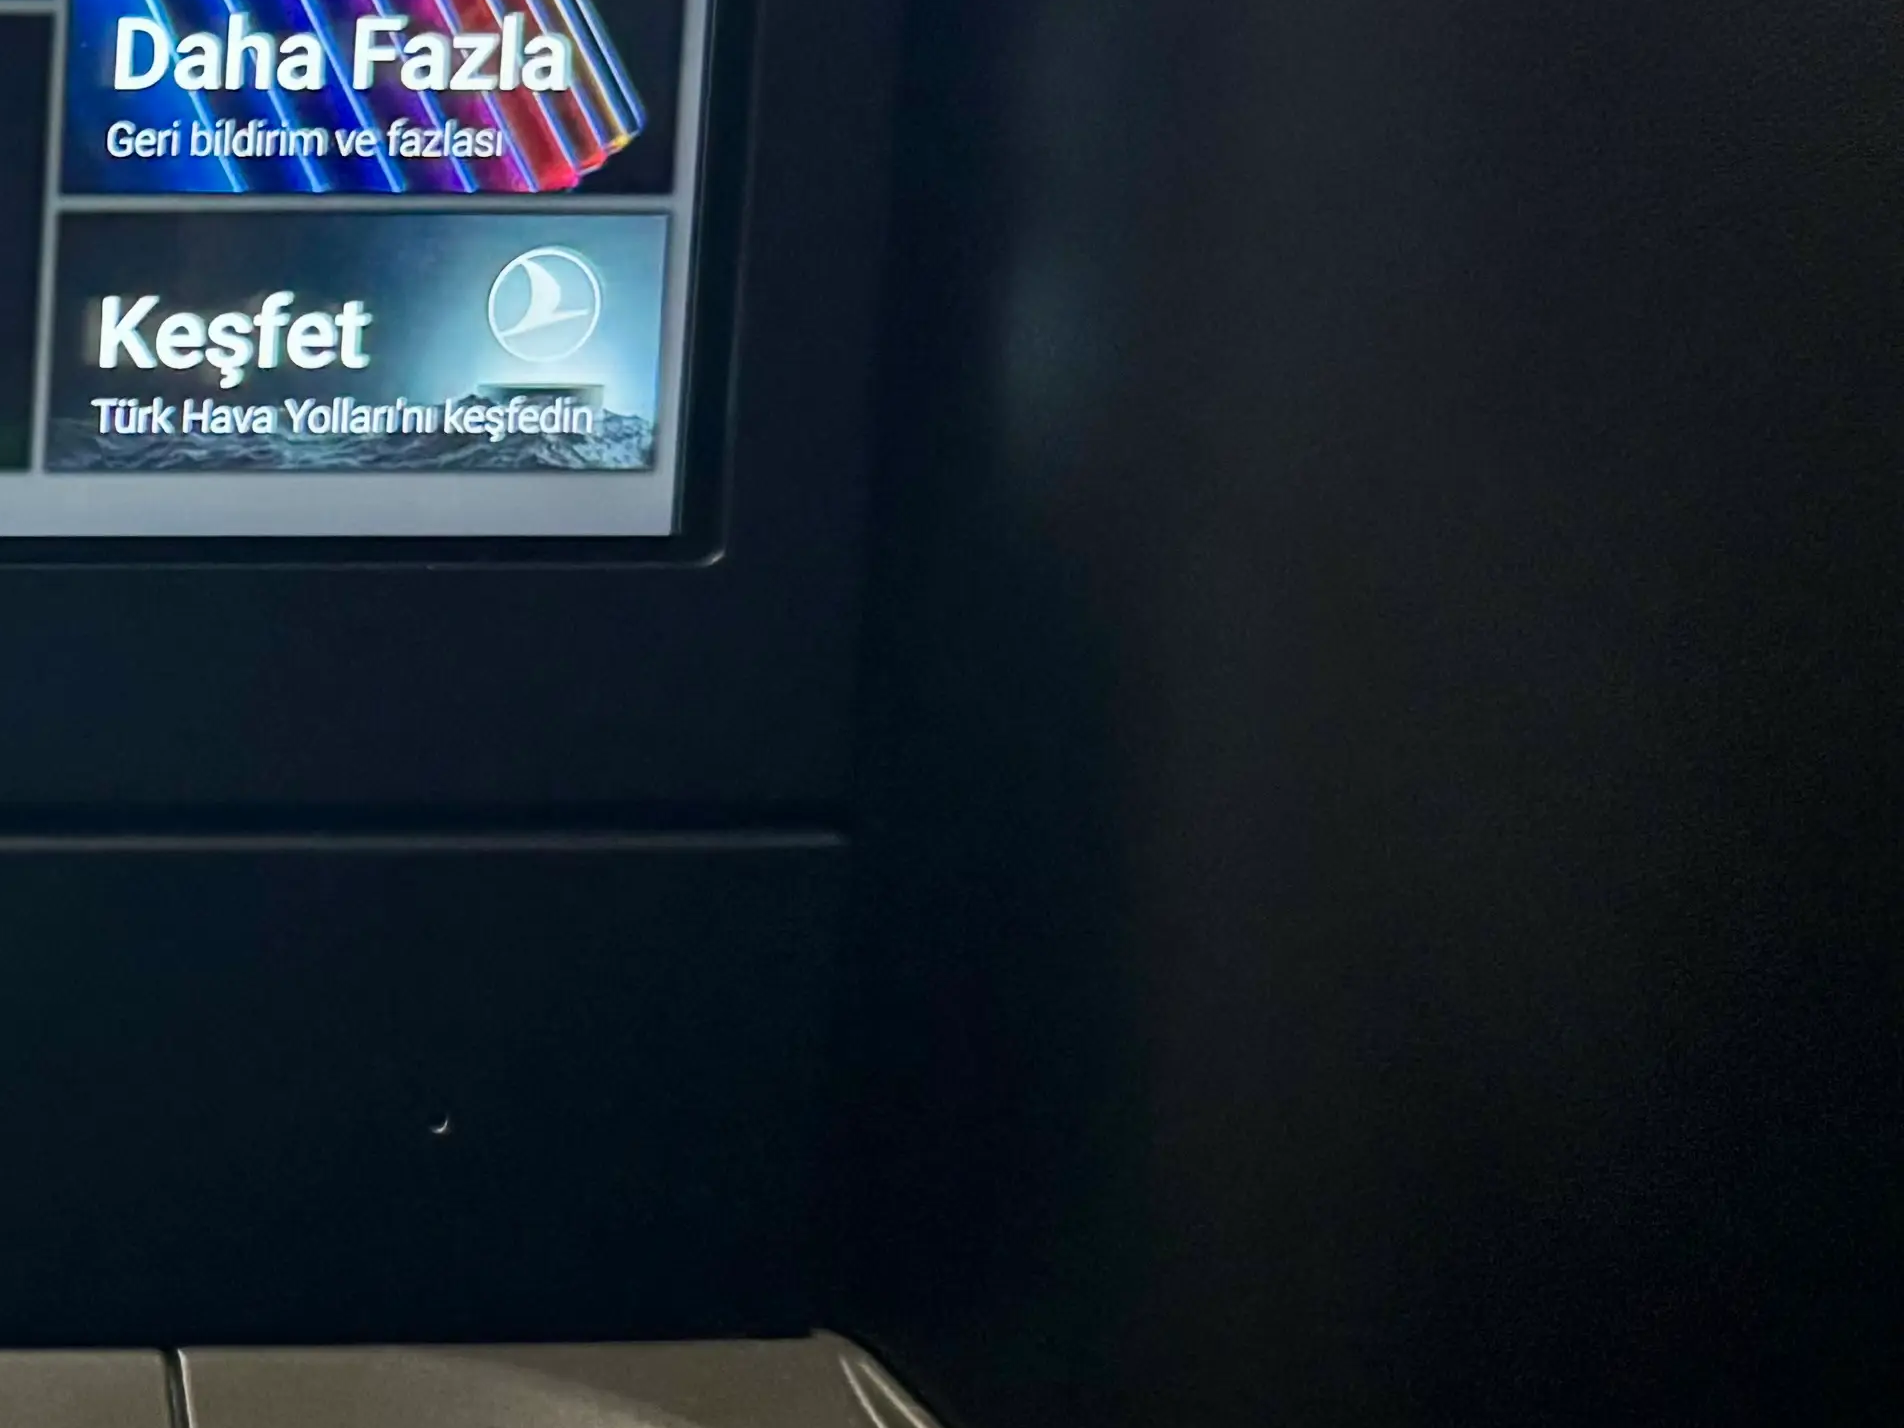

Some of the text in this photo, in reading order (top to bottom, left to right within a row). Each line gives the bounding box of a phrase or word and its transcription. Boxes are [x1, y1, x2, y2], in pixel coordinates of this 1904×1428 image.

[113, 12, 574, 93] Daha Fazla
[105, 120, 504, 159] Geri bildirim ve fazlası
[98, 291, 372, 389] Keşfet
[91, 397, 594, 442] Türk Hava Yolları'nı keşfedin
